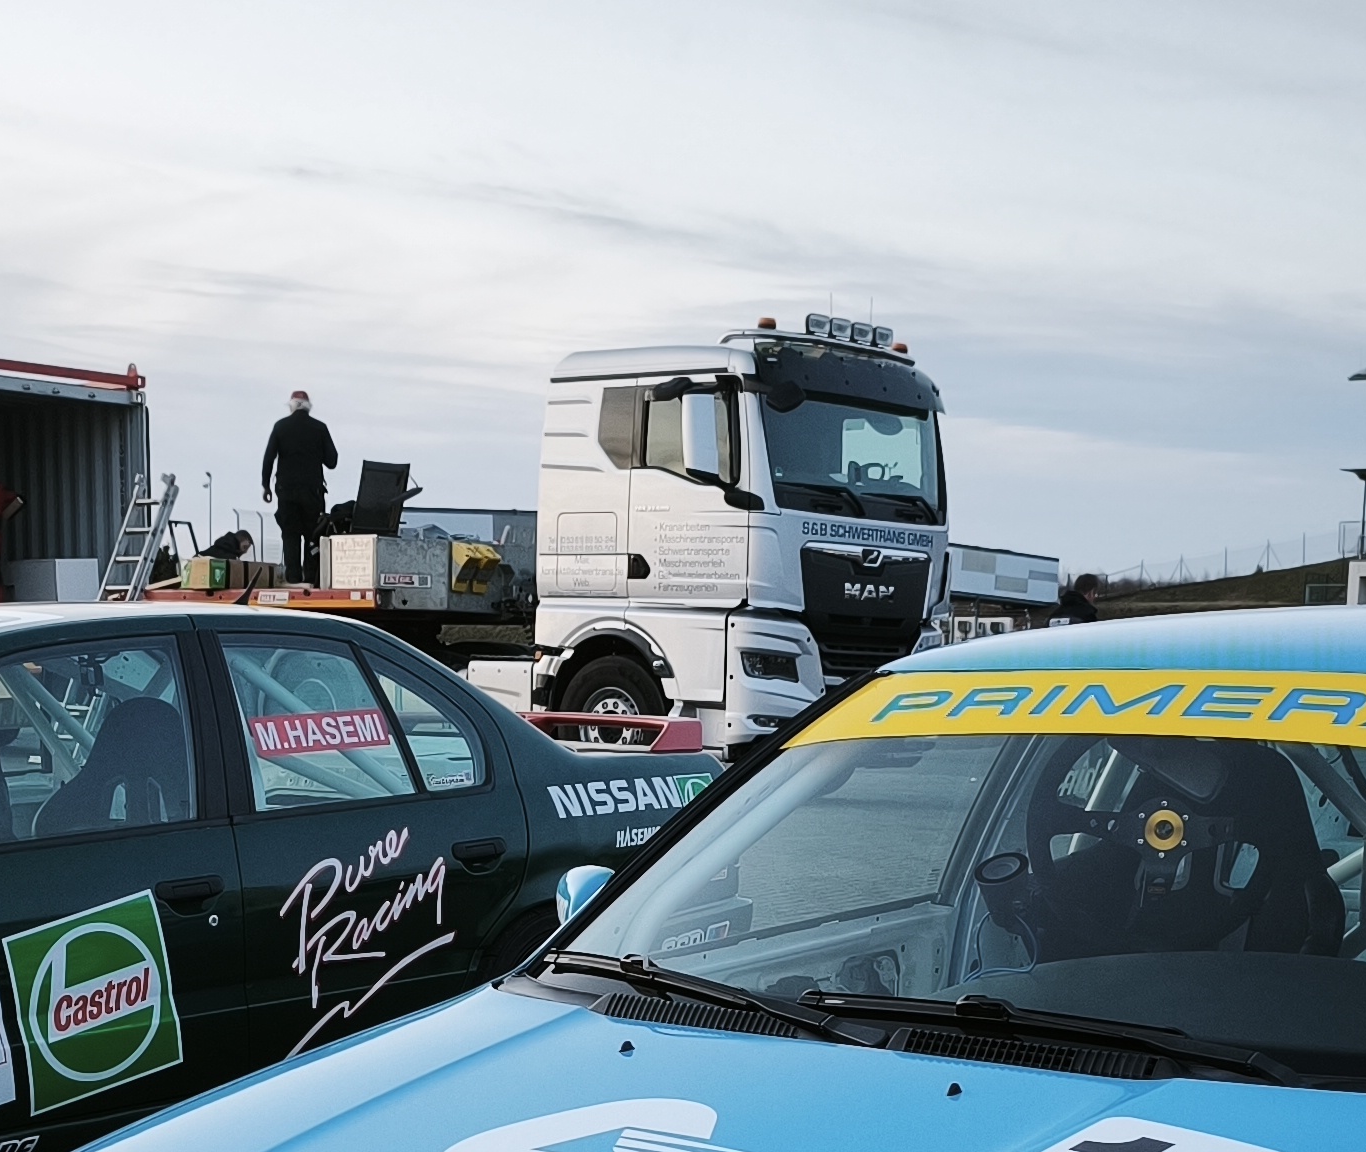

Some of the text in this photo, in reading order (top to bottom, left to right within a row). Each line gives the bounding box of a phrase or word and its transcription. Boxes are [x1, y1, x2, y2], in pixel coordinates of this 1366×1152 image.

[830, 523, 905, 546] SCHWERTRANS
[844, 582, 895, 602] MAN
[255, 713, 387, 752] M.HASEMI
[547, 775, 682, 819] NISSAN
[306, 856, 446, 1009] Racing
[53, 966, 150, 1032] Castrol
